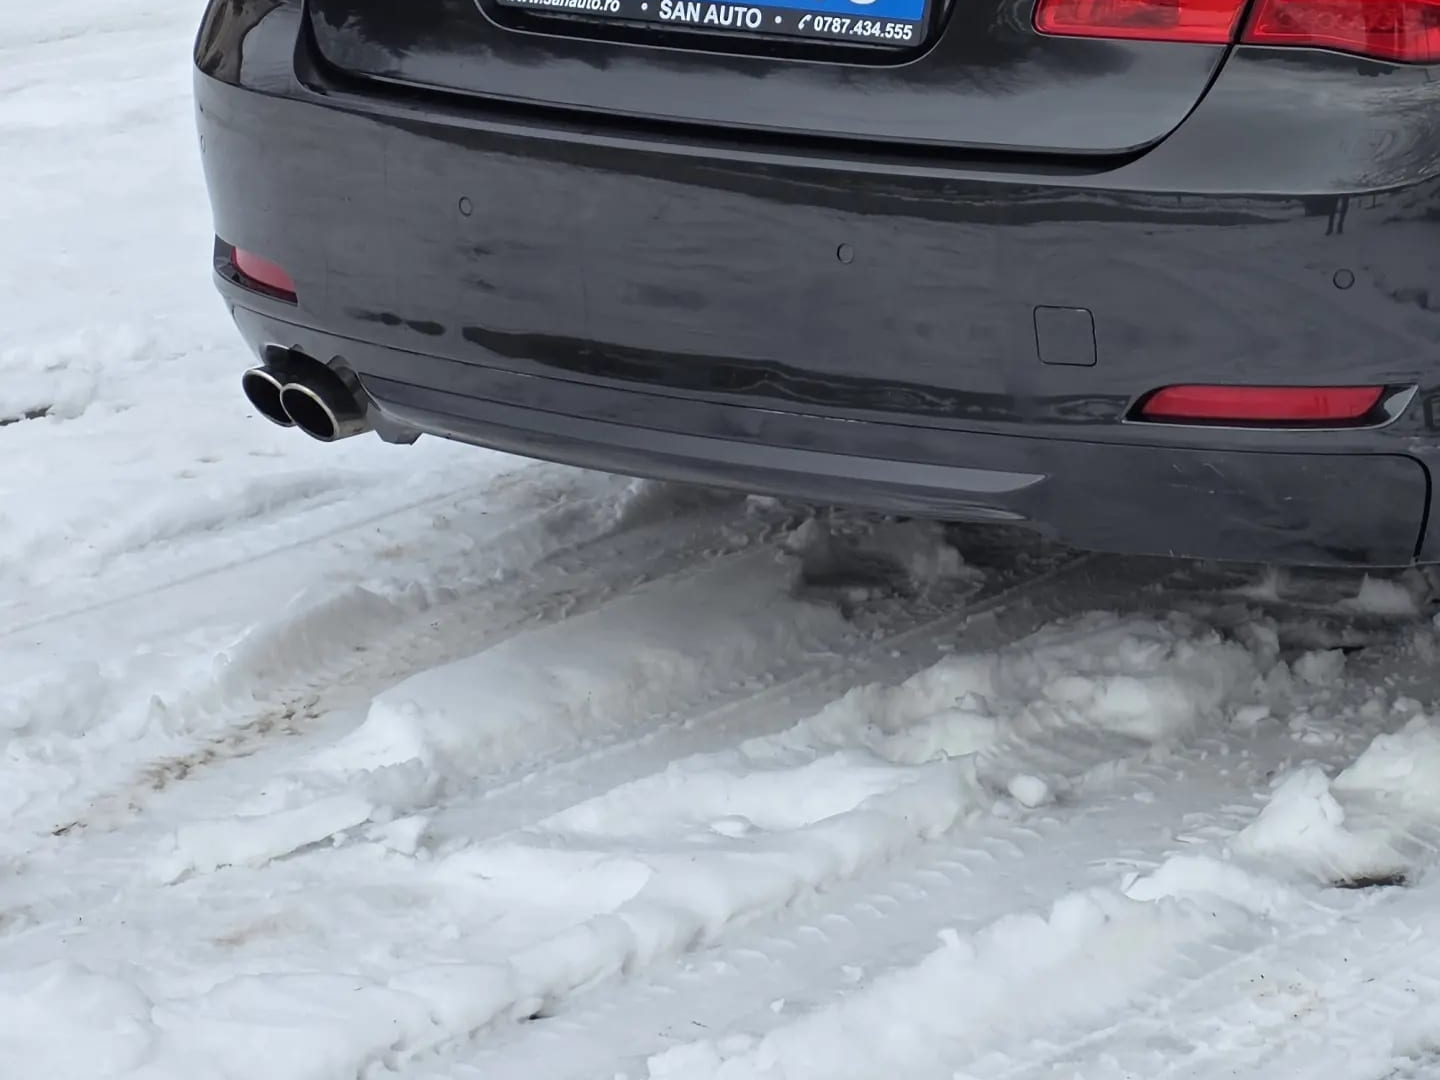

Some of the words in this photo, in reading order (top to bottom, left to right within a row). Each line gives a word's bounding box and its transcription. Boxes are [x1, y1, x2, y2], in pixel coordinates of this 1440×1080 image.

[659, 0, 701, 22] SAN
[703, 4, 762, 29] AUTO
[813, 15, 913, 40] 0787.434.555
